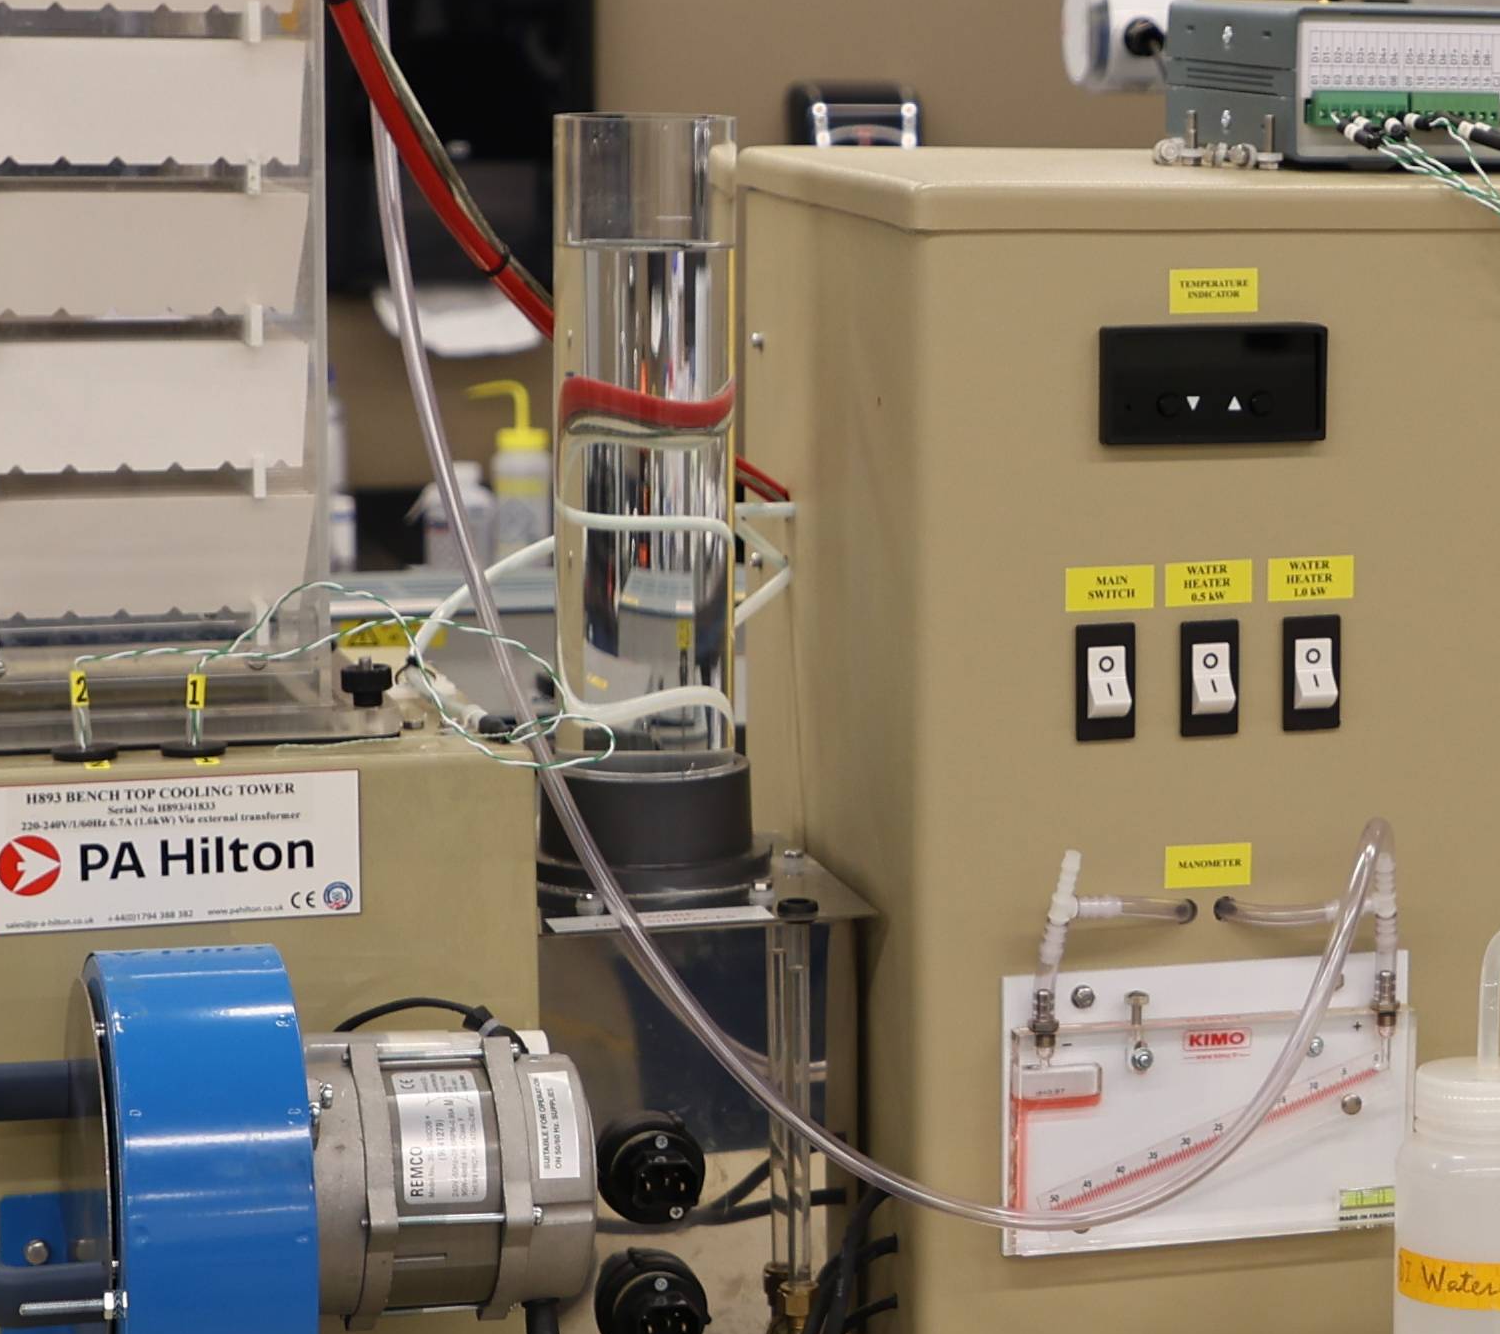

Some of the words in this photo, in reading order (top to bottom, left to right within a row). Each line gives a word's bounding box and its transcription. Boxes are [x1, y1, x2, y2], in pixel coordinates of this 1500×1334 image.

[1179, 278, 1249, 289] TEMPERATURE
[1187, 290, 1240, 299] INDICATOR
[1186, 563, 1227, 575] WATER
[1288, 559, 1330, 571] WATER
[1095, 575, 1128, 586] MAIN
[1183, 577, 1231, 589] HEATER
[1286, 572, 1333, 585] HEATER
[1087, 588, 1135, 600] SWITCH
[1190, 591, 1206, 602] 0.5
[1208, 590, 1225, 602] kW
[1293, 587, 1308, 597] 1.0
[1309, 586, 1326, 597] kW
[76, 675, 88, 703] 2
[188, 679, 200, 706] 1
[26, 790, 62, 805] H893
[66, 788, 120, 804] BENCH
[123, 787, 157, 801] TOP
[159, 784, 233, 800] COOLING
[237, 782, 295, 796] TOWER
[107, 805, 138, 815] Serial
[140, 804, 154, 814] No
[109, 815, 132, 827] 6.7A
[134, 814, 176, 828] (1.6kW)
[179, 814, 195, 825] Via
[197, 812, 239, 824] external
[241, 810, 301, 823] transformer
[79, 841, 146, 883] PA
[160, 835, 315, 877] Hilton
[1178, 857, 1242, 869] MANOMETER
[1188, 1031, 1245, 1047] KIMO
[533, 1077, 545, 1113] OPERATION
[539, 1114, 548, 1130] FOR
[1213, 1123, 1224, 1132] 25
[1181, 1137, 1191, 1146] 30
[540, 1131, 551, 1170] SUITABLE
[1148, 1151, 1158, 1160] 35
[554, 1156, 563, 1170] ON
[410, 1145, 424, 1198] REMCO
[1116, 1165, 1126, 1175] 40
[1083, 1179, 1092, 1189] 45
[1050, 1194, 1060, 1203] 50
